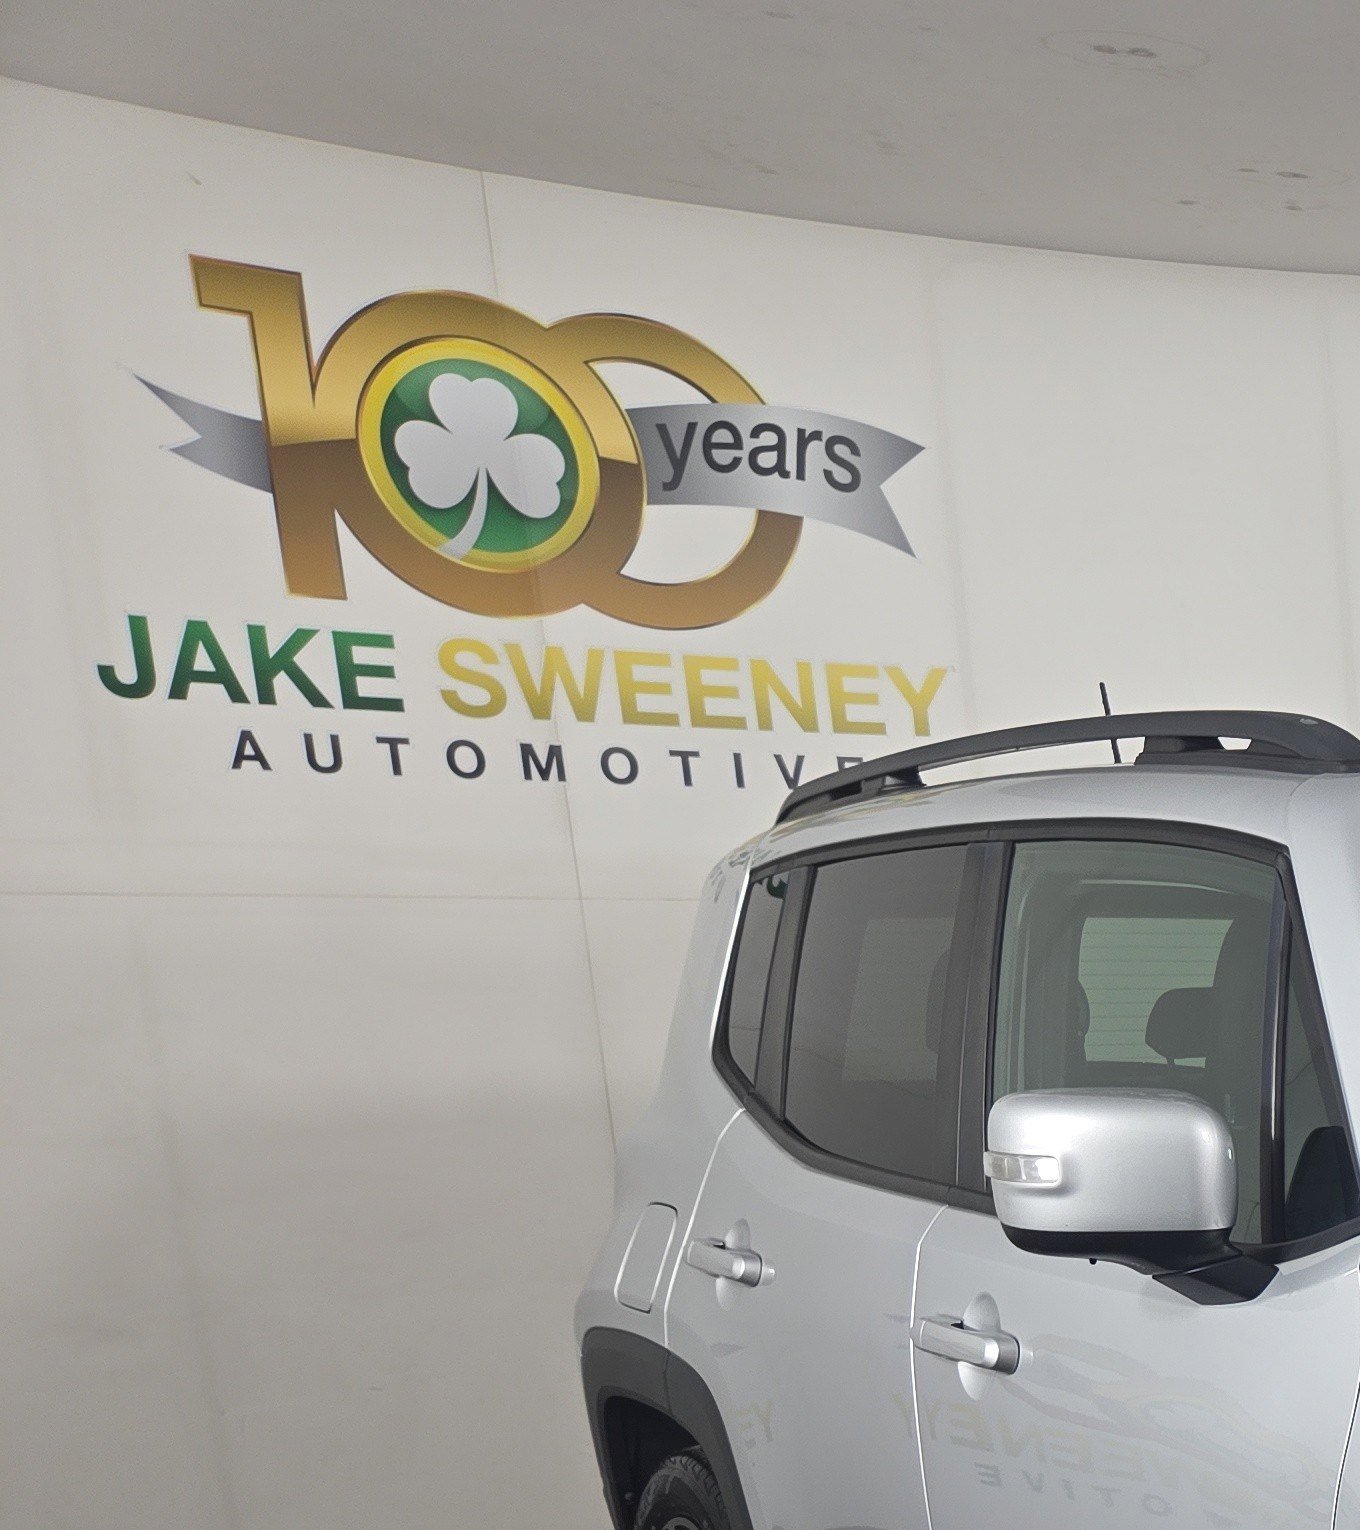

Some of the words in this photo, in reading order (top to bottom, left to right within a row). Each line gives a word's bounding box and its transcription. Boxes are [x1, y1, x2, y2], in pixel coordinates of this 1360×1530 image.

[189, 253, 804, 630] 100
[655, 418, 862, 493] years
[96, 613, 404, 713] JAKE
[437, 637, 948, 738] SWEENEY
